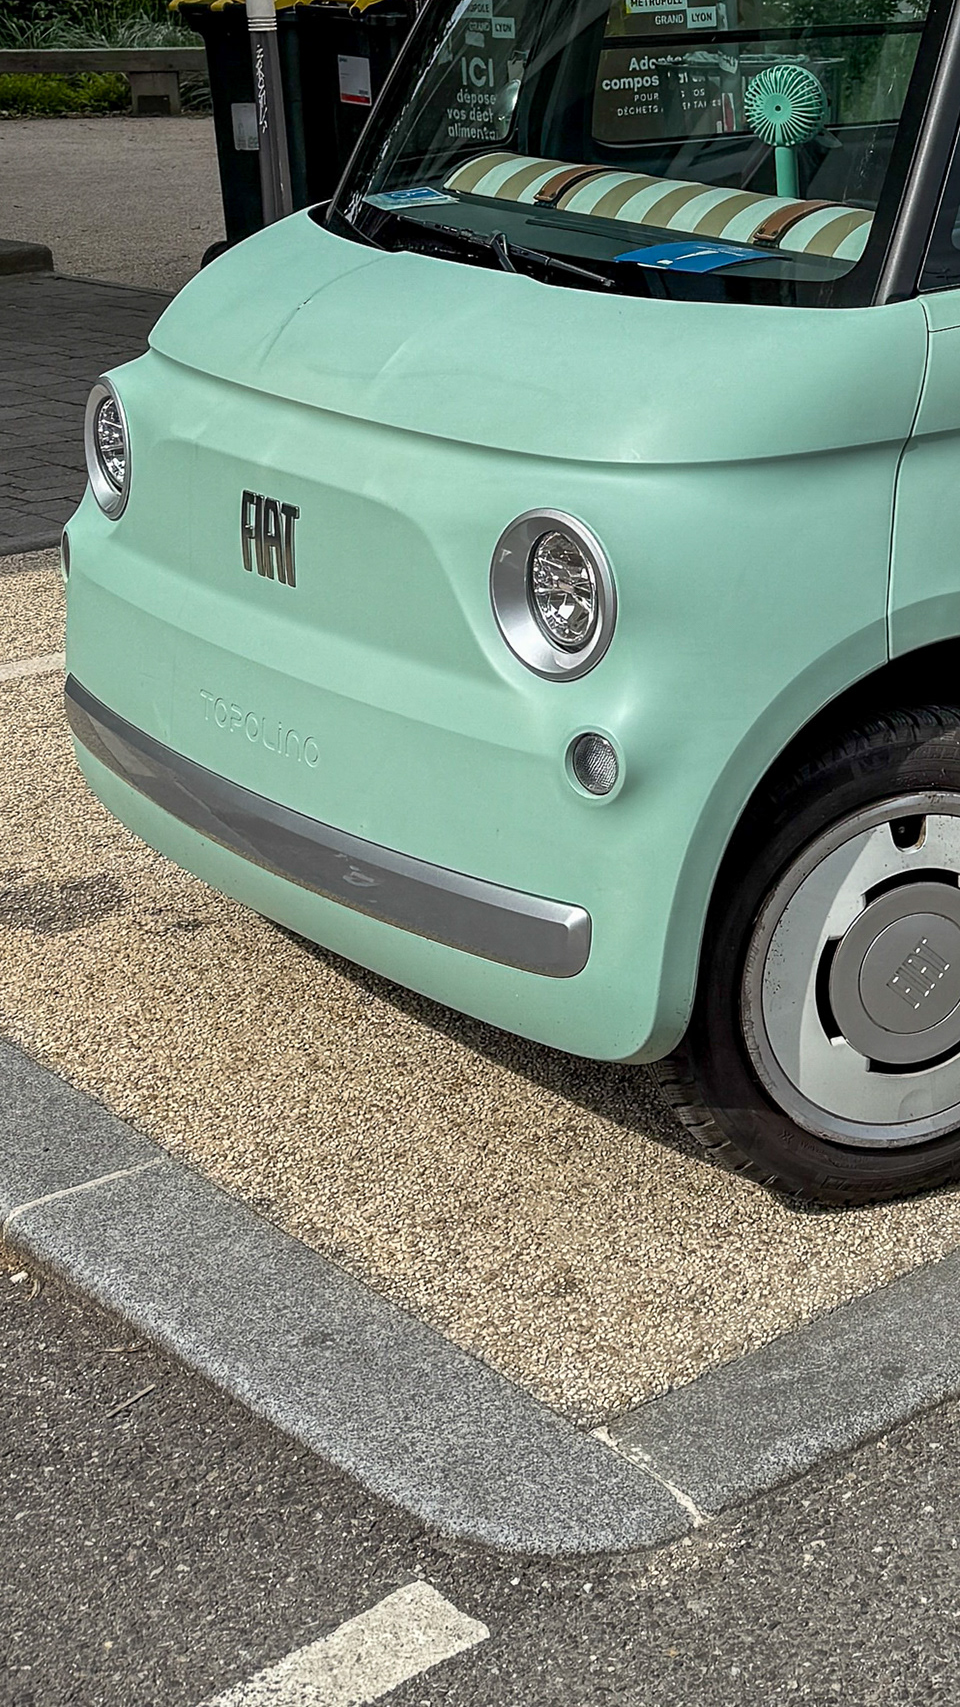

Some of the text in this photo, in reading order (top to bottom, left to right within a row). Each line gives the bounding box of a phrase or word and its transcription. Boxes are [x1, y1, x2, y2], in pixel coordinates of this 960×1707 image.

[655, 12, 713, 25] GRAND LYON
[461, 56, 494, 88] ICI
[634, 93, 659, 103] POUR
[447, 108, 467, 121] vos
[241, 489, 300, 588] FIAT
[886, 936, 950, 1010] FIAT
